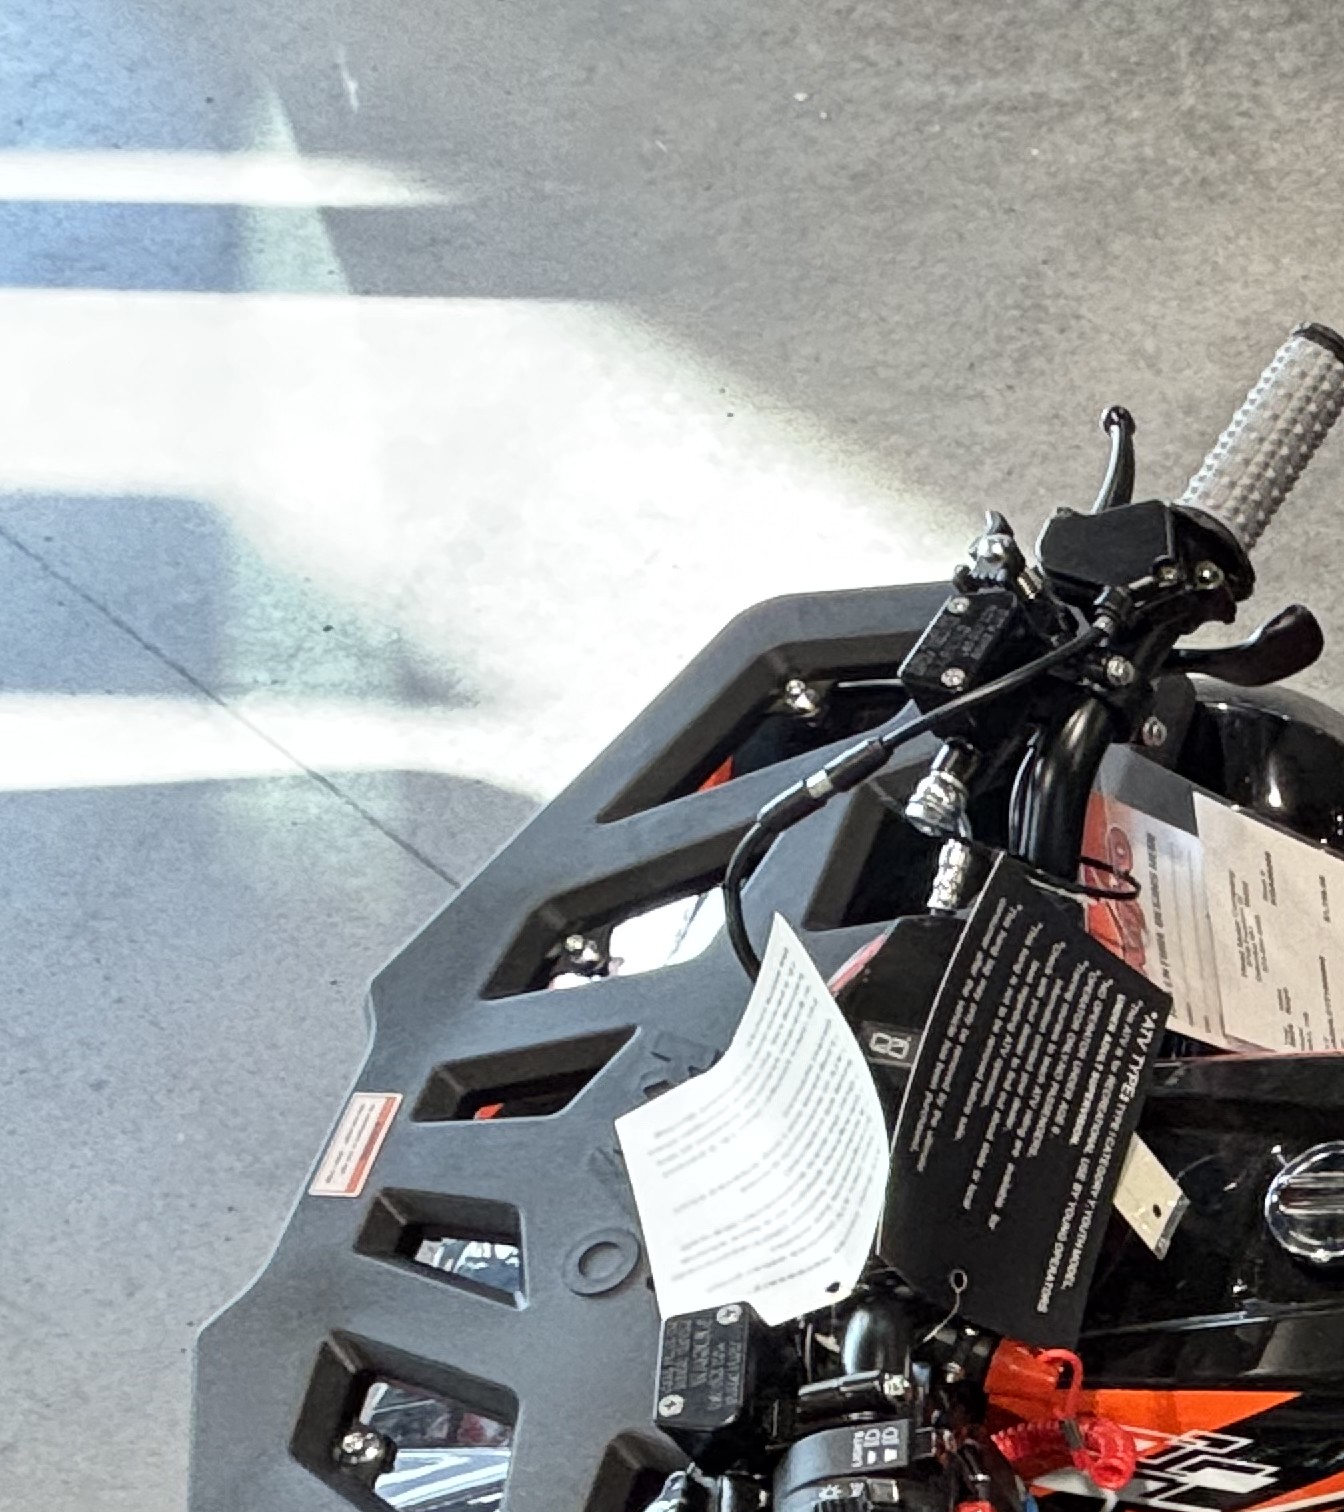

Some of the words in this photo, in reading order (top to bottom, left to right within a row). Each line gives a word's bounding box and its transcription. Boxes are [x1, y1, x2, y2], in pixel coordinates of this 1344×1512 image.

[1103, 992, 1127, 1033] UNDER
[1091, 1031, 1114, 1072] ADULT
[1116, 1053, 1145, 1103] TYPE:
